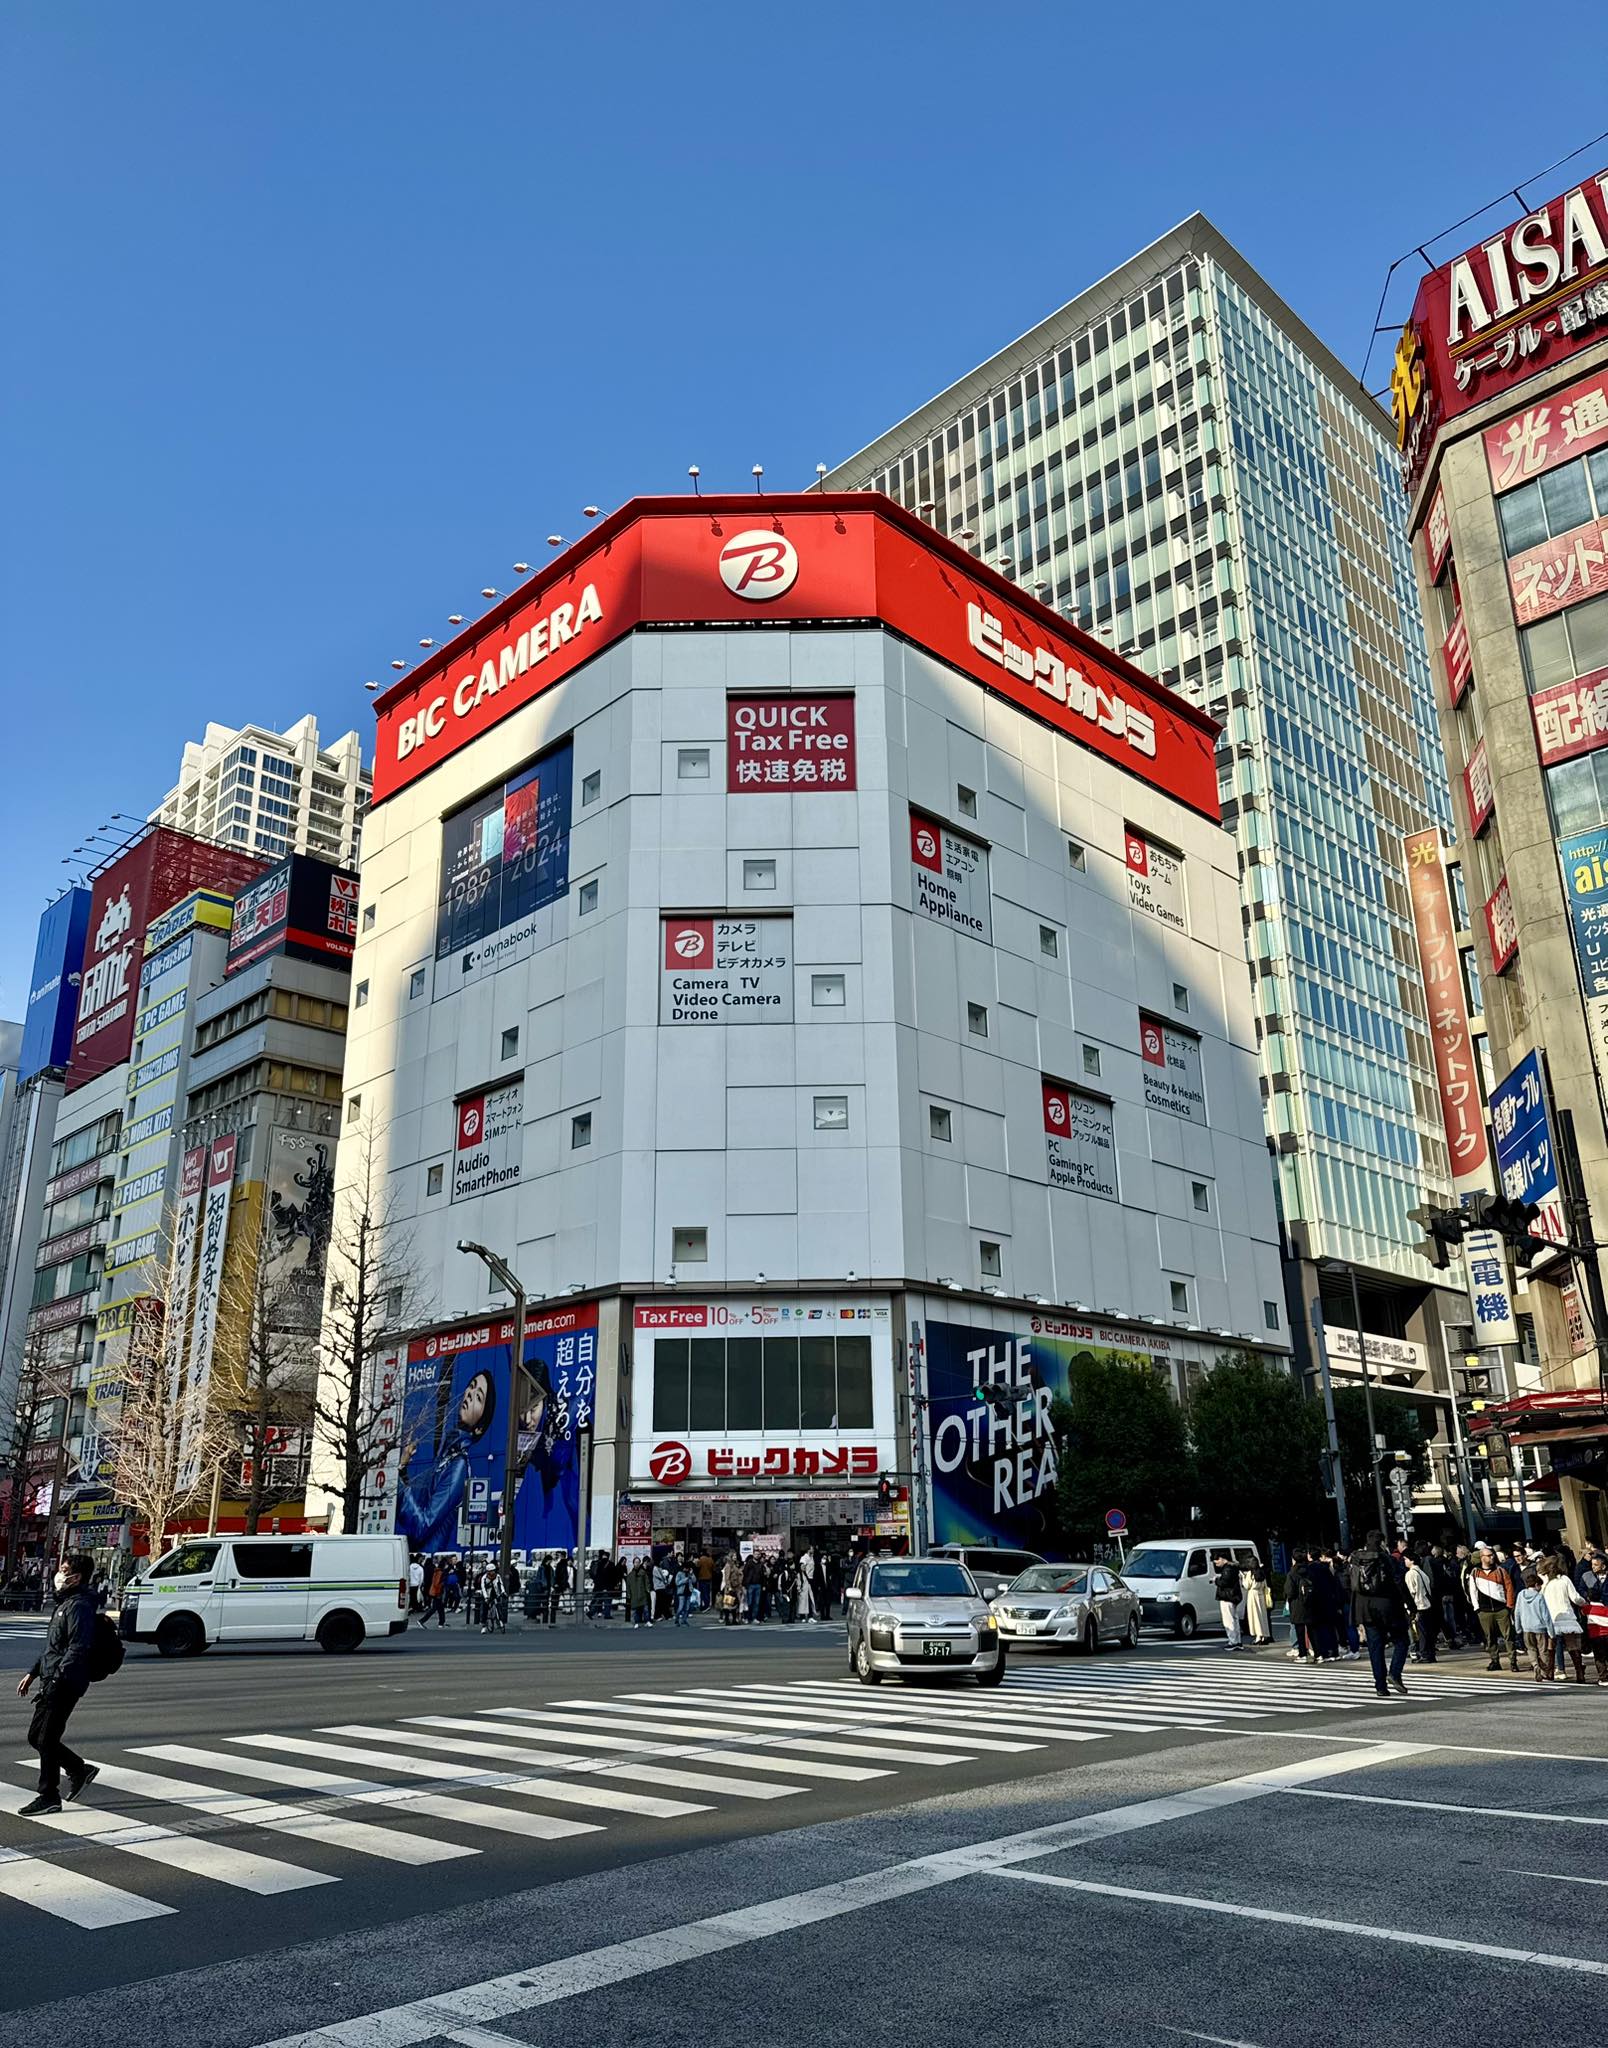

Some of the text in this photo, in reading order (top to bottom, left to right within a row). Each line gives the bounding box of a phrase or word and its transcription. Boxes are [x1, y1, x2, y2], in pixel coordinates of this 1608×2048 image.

[1446, 172, 1608, 346] AISA
[1512, 528, 1608, 608] ネット
[397, 583, 603, 761] BIC CAMERA
[967, 601, 1157, 757] ビックカメラ
[735, 706, 828, 730] QUICK
[735, 730, 848, 750] Tax Free
[736, 758, 847, 784] 快速免税
[511, 825, 562, 881] 2024
[946, 853, 975, 873] エアコン
[918, 872, 956, 903] Home
[1128, 873, 1151, 895] Toys
[1151, 866, 1172, 885] ゲーム
[255, 889, 287, 933] 天国
[919, 892, 983, 931] Appliance
[1130, 890, 1184, 927] Video Games
[152, 906, 194, 947] TRADER
[484, 923, 537, 958] dynabook
[718, 924, 756, 935] カメラ
[718, 940, 756, 952] テレビ
[717, 957, 786, 969] ビデオカメラ
[78, 939, 135, 1023] GAME
[673, 977, 760, 989] Camera TV
[143, 990, 186, 1032] PC GAME
[673, 993, 781, 1005] Video Camera
[672, 1008, 718, 1020] Drone
[487, 1088, 518, 1108] オーディオ
[1143, 1073, 1203, 1104] Beauty & Health
[1145, 1090, 1190, 1115] Cosmetics
[485, 1103, 523, 1124] スマートフォン
[1070, 1100, 1096, 1115] パソコン
[129, 1107, 172, 1146] MODEL KITS
[1072, 1128, 1110, 1149] アップル製品
[1048, 1139, 1060, 1152] PC
[457, 1152, 489, 1175] Audio
[1049, 1154, 1094, 1176] Gaming PC
[122, 1169, 164, 1206] FIGURE
[456, 1165, 519, 1196] SmartPhone
[1050, 1169, 1113, 1195] Apple Products
[115, 1232, 158, 1267] VIDEO GAME
[640, 1310, 667, 1323] Tax
[670, 1310, 703, 1323] Free
[710, 1306, 728, 1325] 10
[751, 1306, 763, 1324] 5
[439, 1328, 490, 1351] ビックカメラ
[501, 1312, 575, 1339] Bicamera.com
[1044, 1323, 1093, 1339] ビックカメラ
[1099, 1330, 1113, 1342] BIC
[1114, 1332, 1146, 1348] CAMERA
[1148, 1337, 1171, 1351] AKIBA
[409, 1364, 436, 1383] Haier
[575, 1333, 594, 1428] 自分を
[967, 1336, 1032, 1399] THE
[555, 1337, 574, 1441] 超えろ。
[934, 1386, 1054, 1473] OTHER
[708, 1447, 878, 1476] ビックカメラ
[472, 1482, 485, 1499] P
[994, 1447, 1058, 1514] REA
